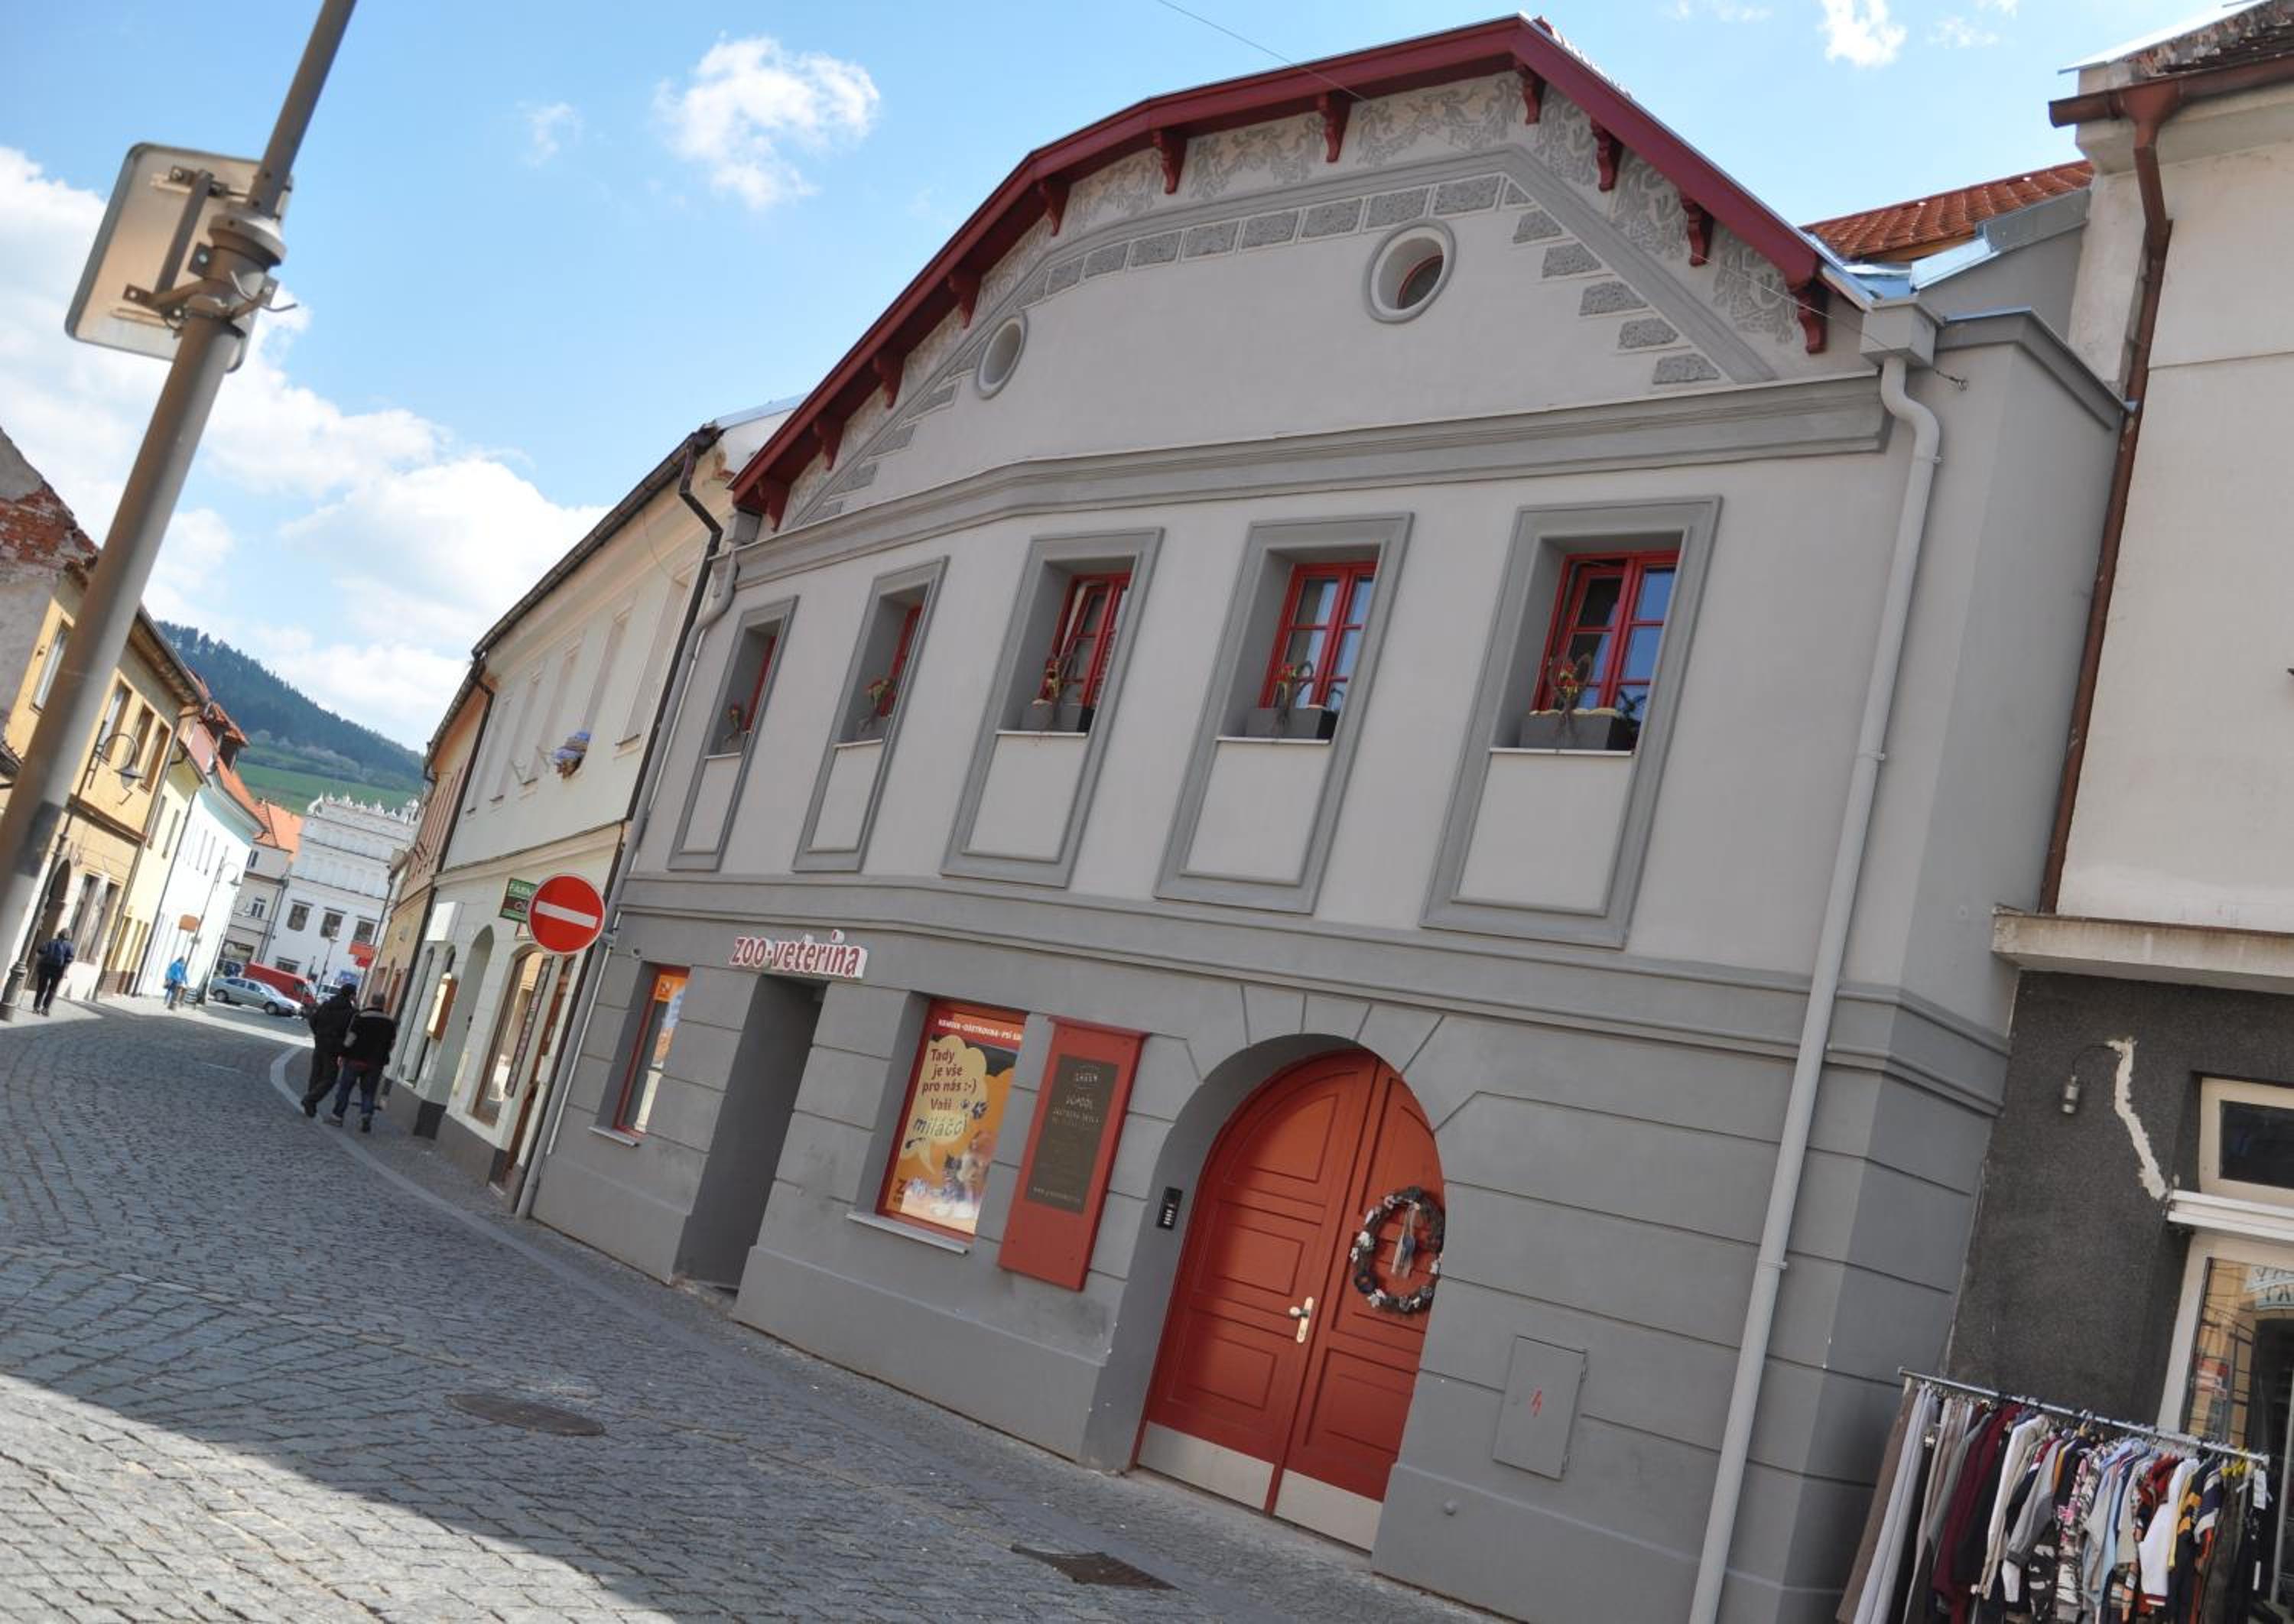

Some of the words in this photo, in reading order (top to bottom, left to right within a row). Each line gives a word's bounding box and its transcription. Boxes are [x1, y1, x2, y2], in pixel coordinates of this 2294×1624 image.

[931, 1048, 955, 1064] Tady
[931, 1064, 943, 1080] je
[921, 1081, 941, 1096] pro
